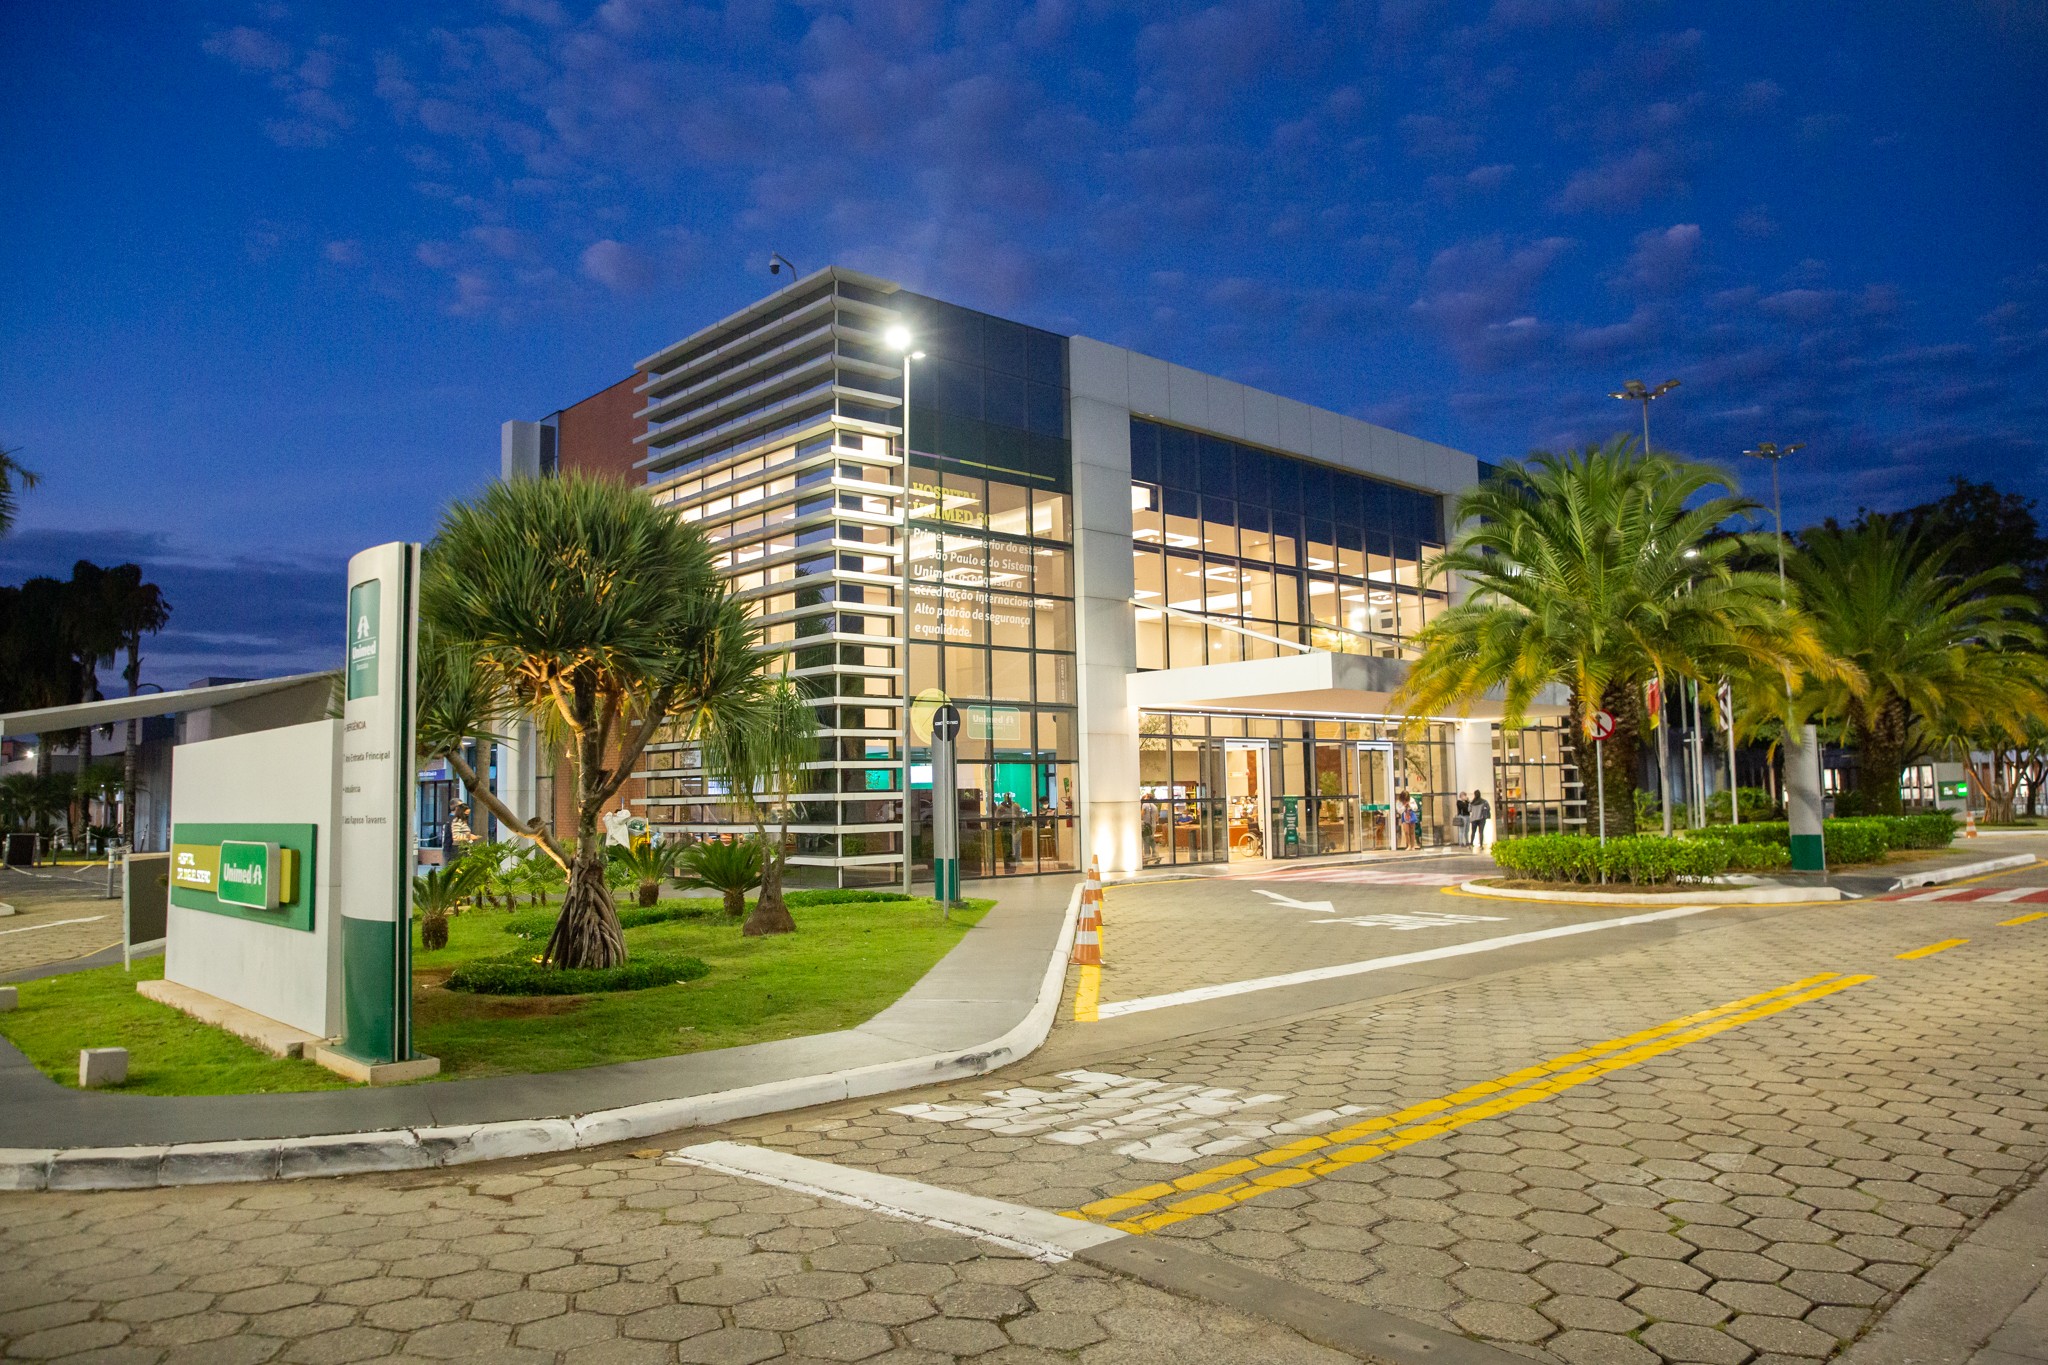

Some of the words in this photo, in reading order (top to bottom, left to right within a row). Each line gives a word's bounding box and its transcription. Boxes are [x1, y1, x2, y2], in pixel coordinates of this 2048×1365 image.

[1005, 541, 1018, 552] do
[950, 551, 979, 566] Paulo
[980, 558, 987, 566] e
[988, 556, 1000, 568] do
[1002, 558, 1038, 573] Sistema
[1016, 581, 1022, 589] a
[914, 602, 936, 615] Alto
[936, 605, 971, 619] padrão
[972, 608, 984, 620] de
[984, 612, 1031, 628] segurança
[914, 624, 921, 633] e
[921, 623, 972, 638] qualidade.
[352, 639, 377, 660] Unimed
[972, 714, 1004, 724] Unimed
[365, 750, 391, 763] Principal
[365, 814, 387, 825] Tavares
[223, 863, 252, 884] Unimed
